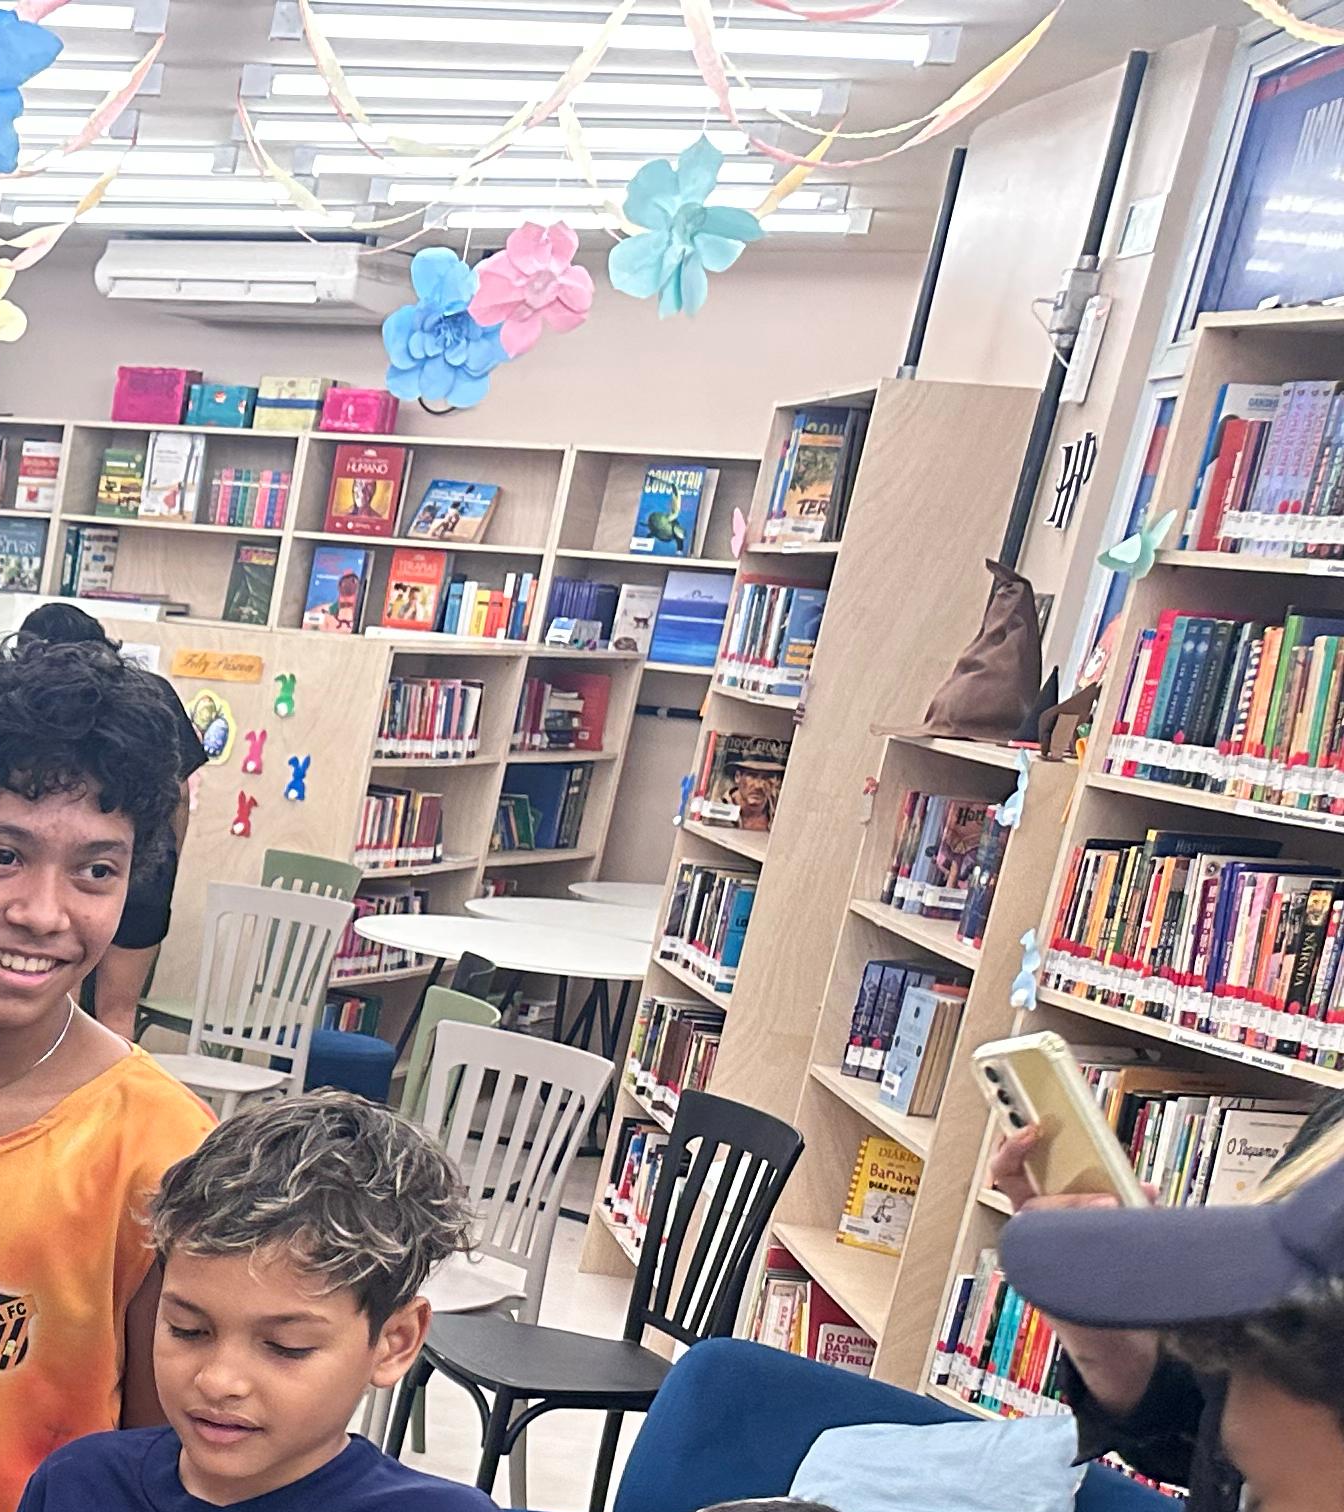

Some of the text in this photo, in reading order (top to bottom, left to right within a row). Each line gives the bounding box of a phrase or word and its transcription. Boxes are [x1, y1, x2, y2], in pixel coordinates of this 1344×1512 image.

[346, 463, 389, 475] HUMANO
[1293, 931, 1317, 987] NARNIA
[1226, 1137, 1237, 1155] O
[870, 1162, 920, 1186] Banana
[7, 1302, 27, 1320] FC
[826, 1332, 835, 1342] O
[825, 1342, 850, 1354] DAS
